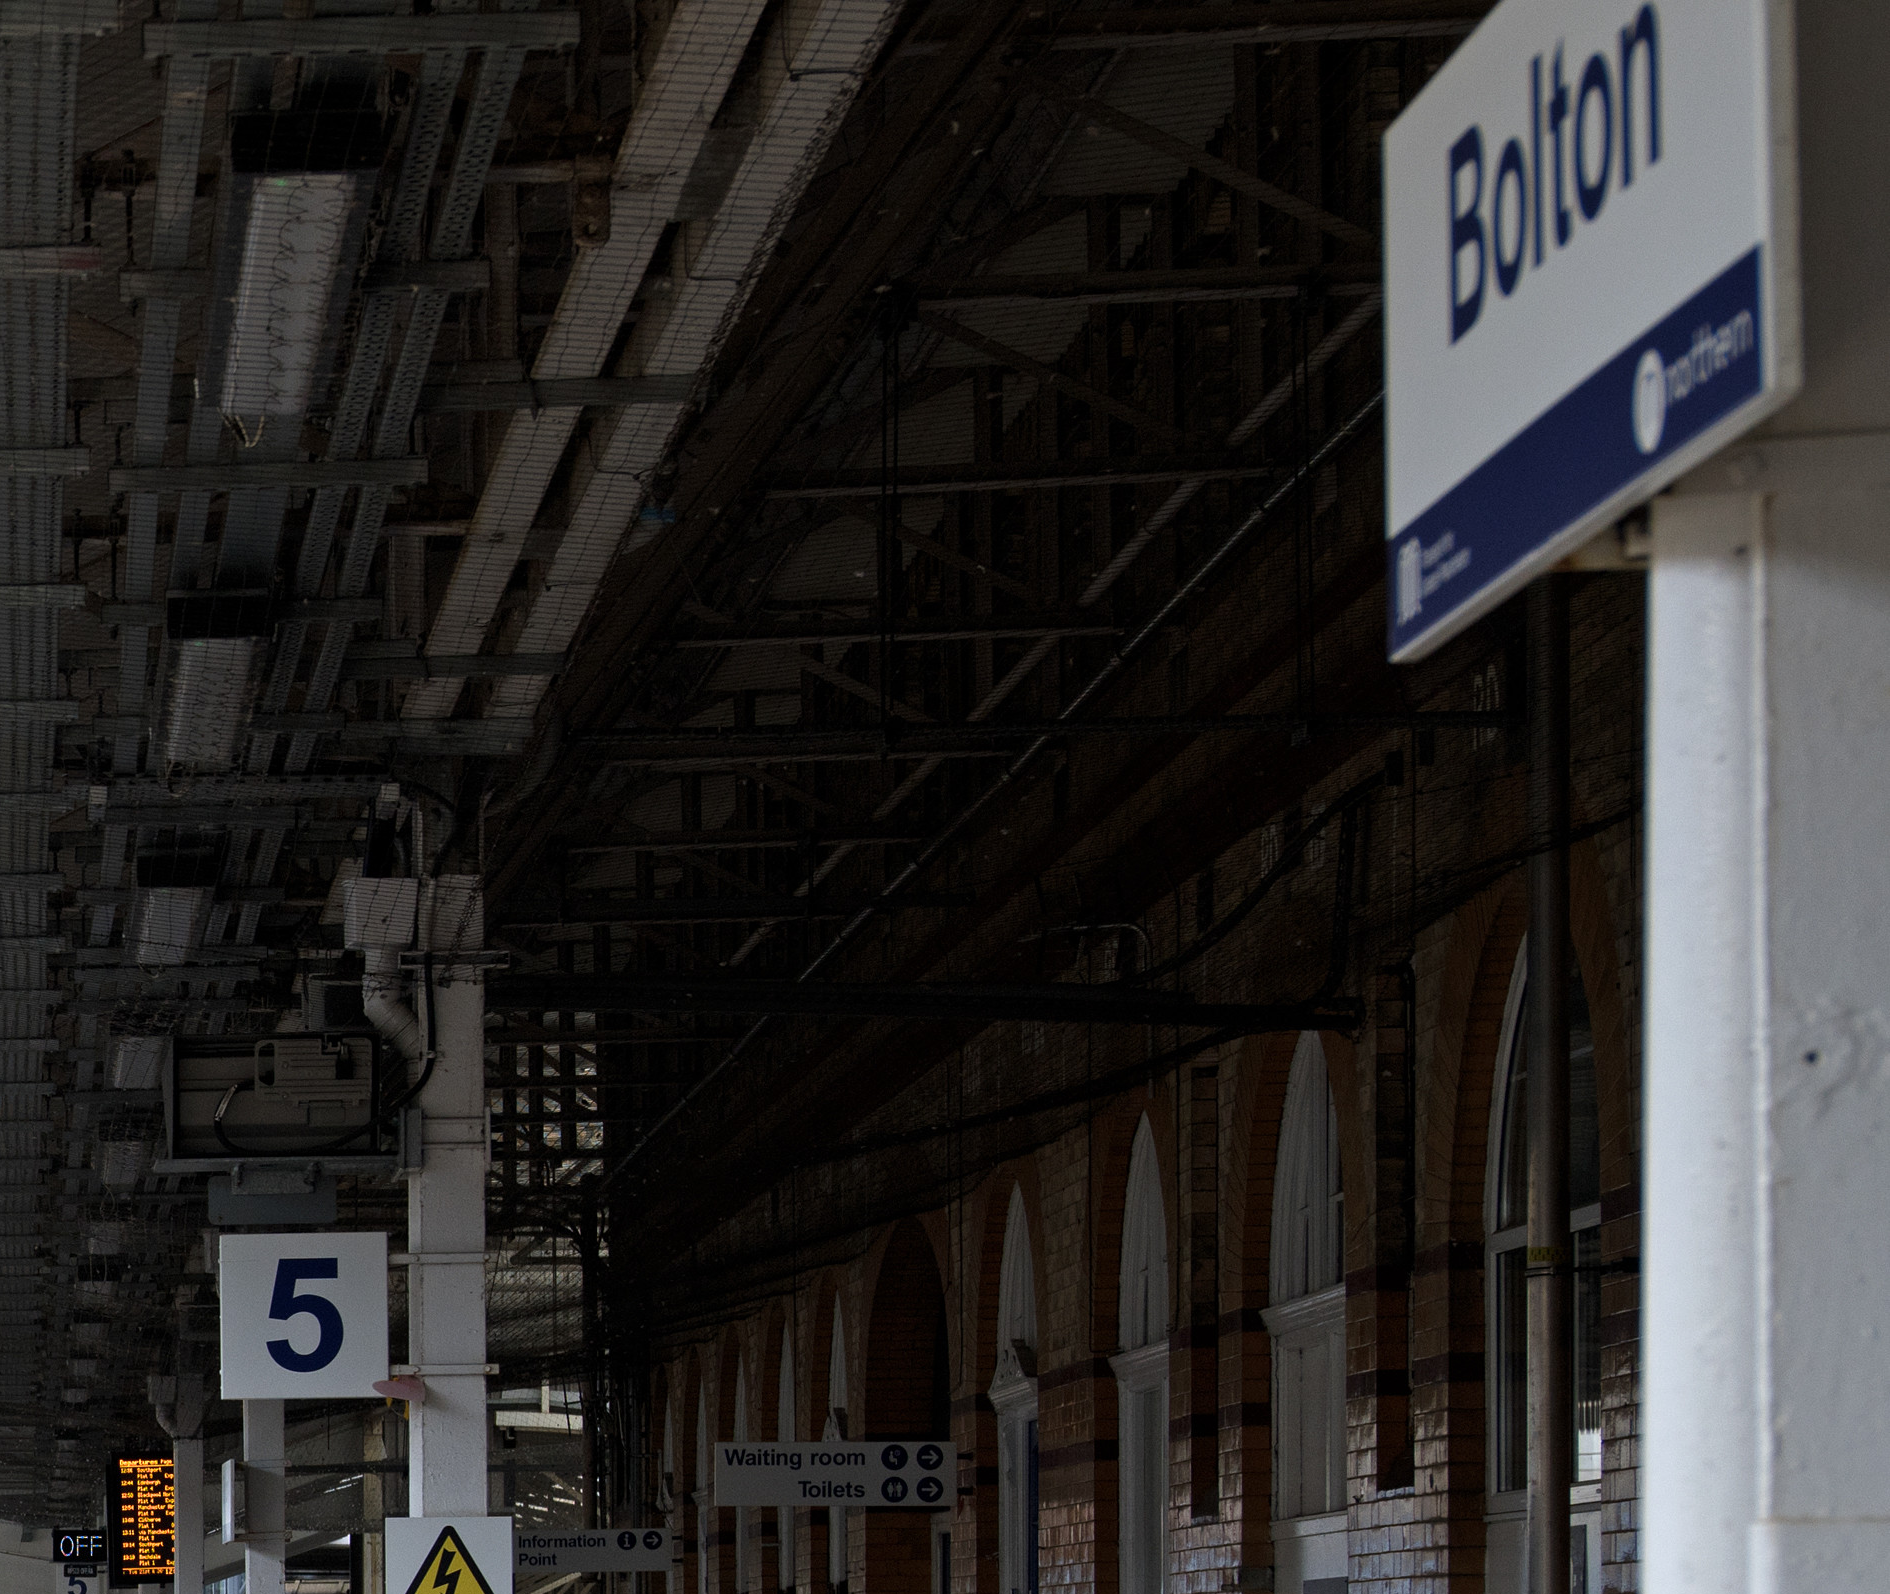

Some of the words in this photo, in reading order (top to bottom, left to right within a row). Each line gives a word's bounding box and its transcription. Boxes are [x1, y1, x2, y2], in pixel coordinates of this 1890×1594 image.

[1448, 3, 1662, 345] Bolton
[266, 1258, 344, 1372] 5
[724, 1448, 802, 1471] Waiting
[810, 1452, 866, 1466] room
[798, 1480, 866, 1498] Toilets
[60, 1536, 102, 1556] OFF
[518, 1535, 606, 1548] Information
[518, 1553, 558, 1566] Point
